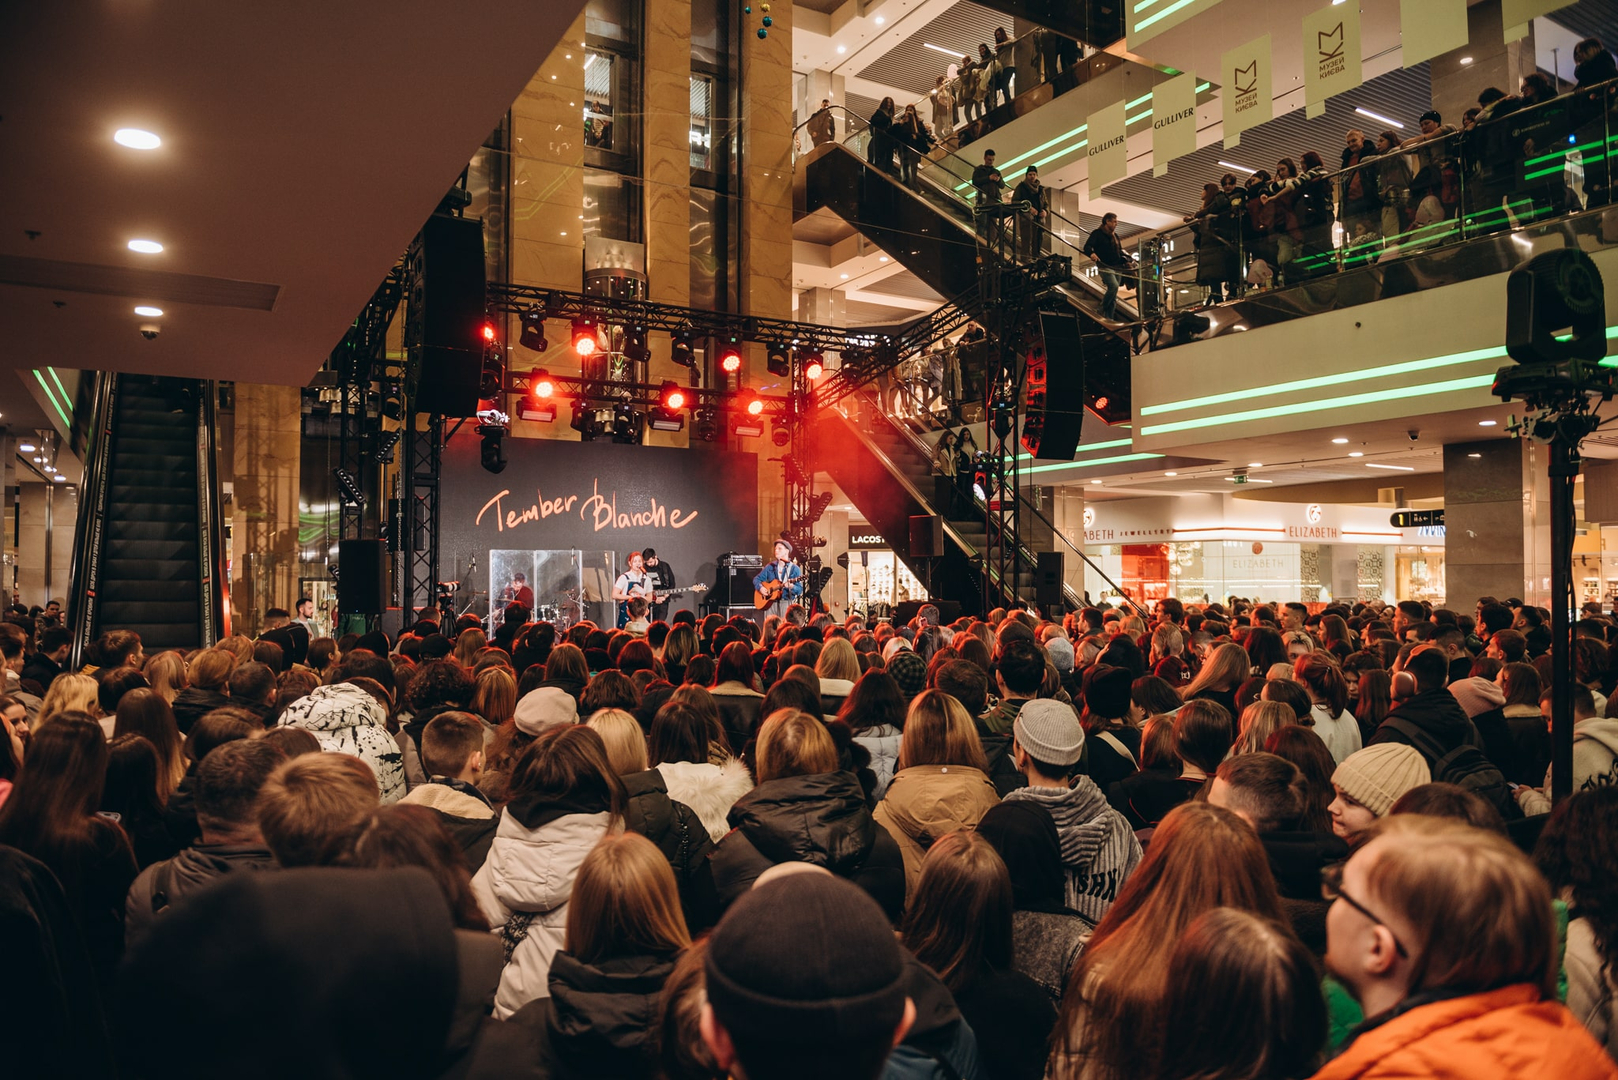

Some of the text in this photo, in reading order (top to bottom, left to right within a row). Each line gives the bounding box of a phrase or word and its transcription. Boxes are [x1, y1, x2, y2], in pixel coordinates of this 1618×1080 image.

[1319, 56, 1345, 73] МУЗЕЙ
[1319, 64, 1346, 80] КИЄВА
[1235, 93, 1258, 107] МУЗЕЙ
[1235, 100, 1258, 114] КИЄВА
[1154, 107, 1194, 130] GULLIVER
[1089, 135, 1124, 157] GULLIVER
[476, 477, 698, 532] Tember Blanche
[1399, 514, 1404, 526] 1
[1289, 526, 1337, 538] ELIZABETH
[1233, 559, 1284, 569] ELIZABETH
